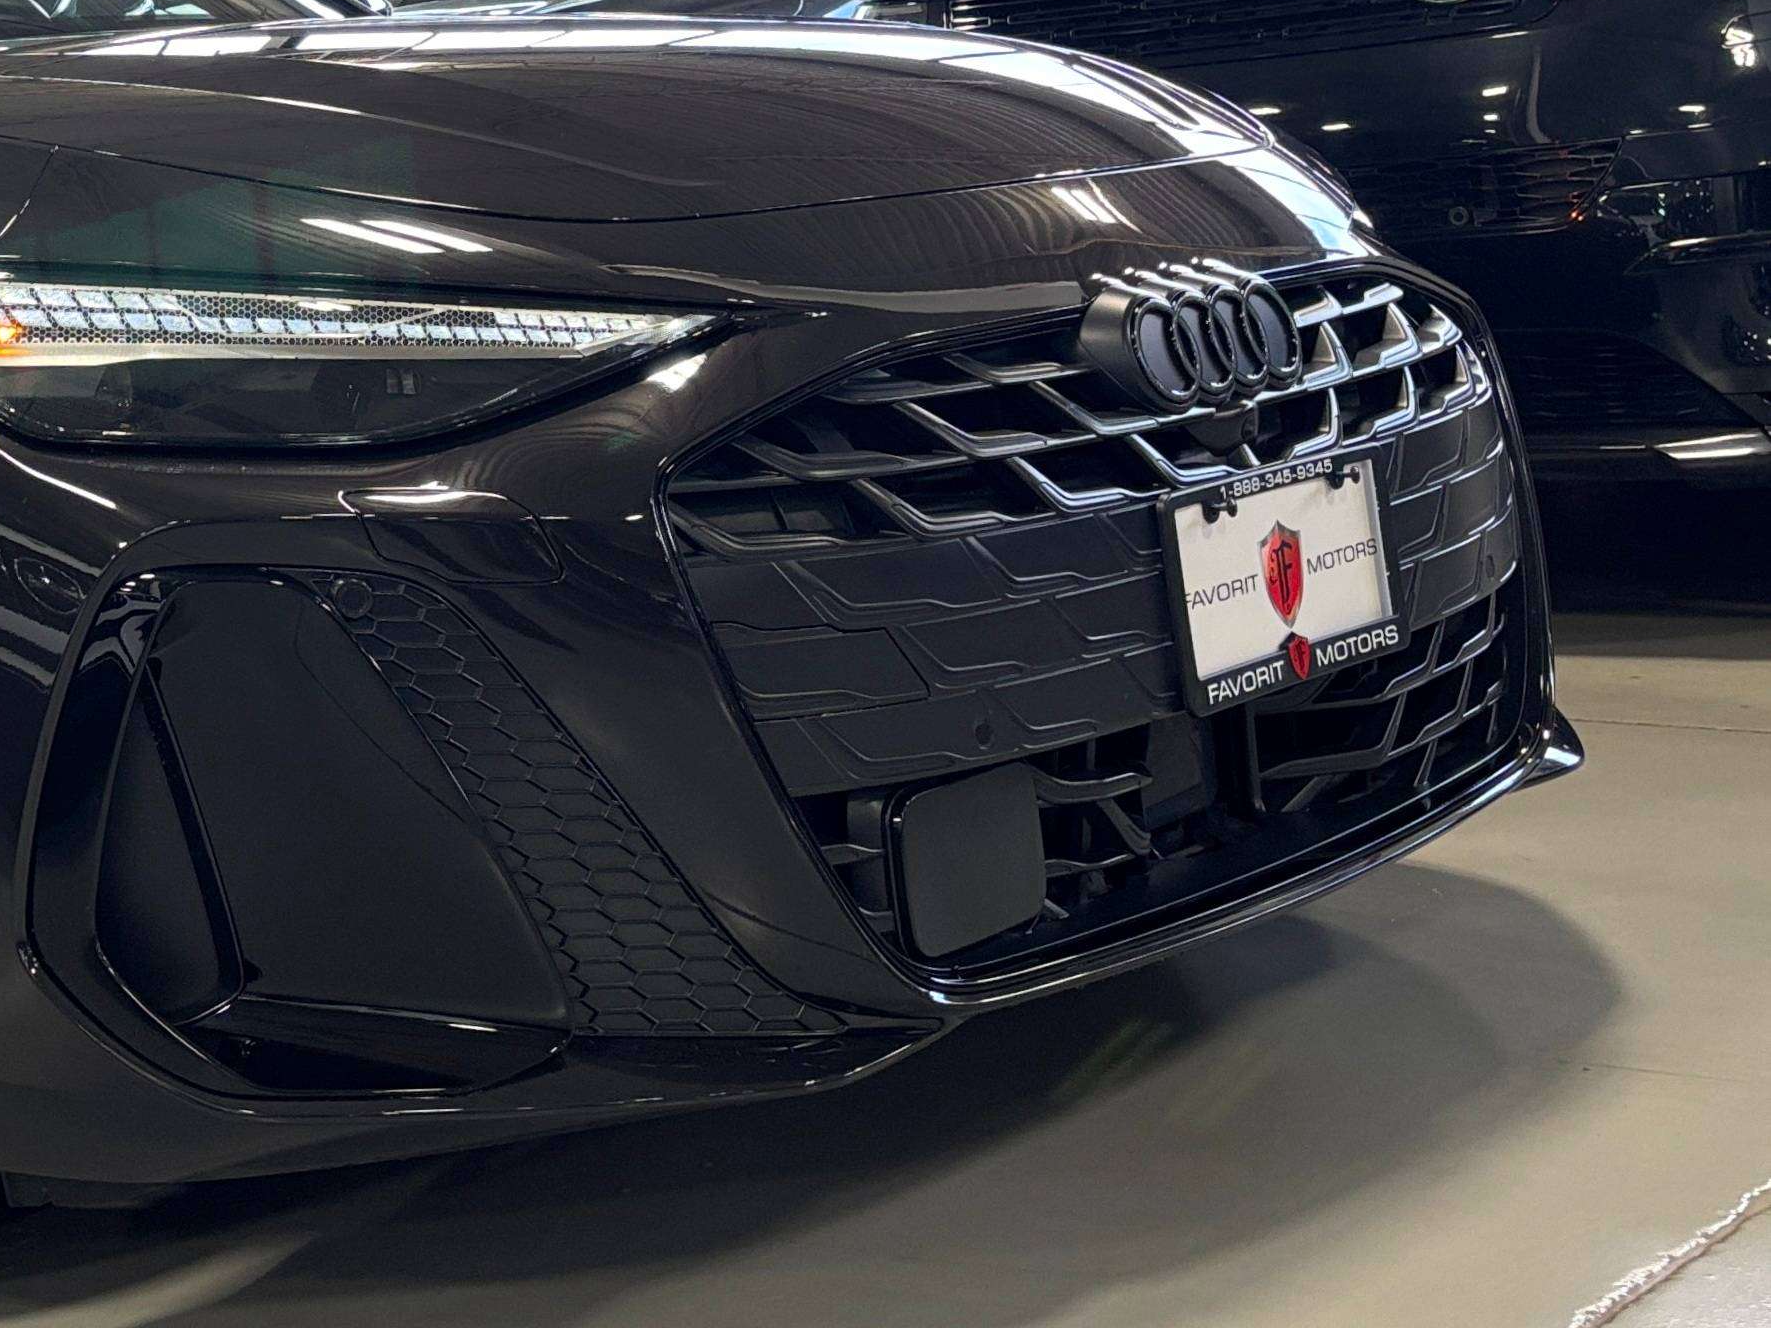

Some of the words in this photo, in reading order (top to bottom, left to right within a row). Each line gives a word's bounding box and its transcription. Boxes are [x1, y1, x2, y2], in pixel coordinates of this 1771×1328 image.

[1220, 458, 1333, 500] 1-888-345-9345
[1306, 537, 1378, 575] MOTORS
[1207, 660, 1285, 705] FAVORIT
[1316, 624, 1400, 668] MOTORS
